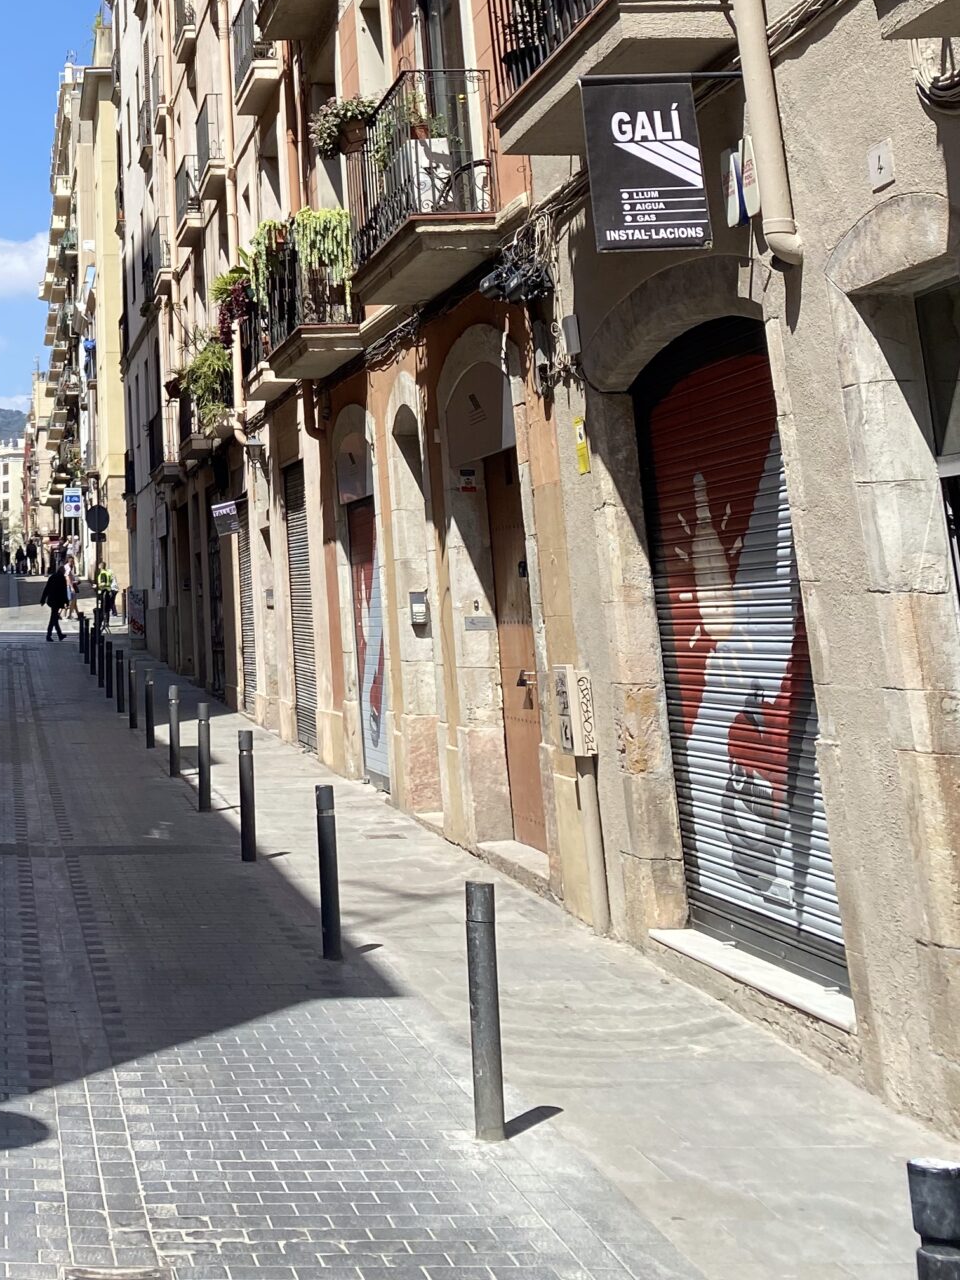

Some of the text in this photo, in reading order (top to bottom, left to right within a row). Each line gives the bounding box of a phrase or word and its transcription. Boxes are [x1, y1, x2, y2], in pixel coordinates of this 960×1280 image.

[611, 102, 682, 142] GALÍ
[633, 190, 659, 199] LLUM
[635, 202, 666, 210] AIGUA
[636, 213, 657, 222] GAS
